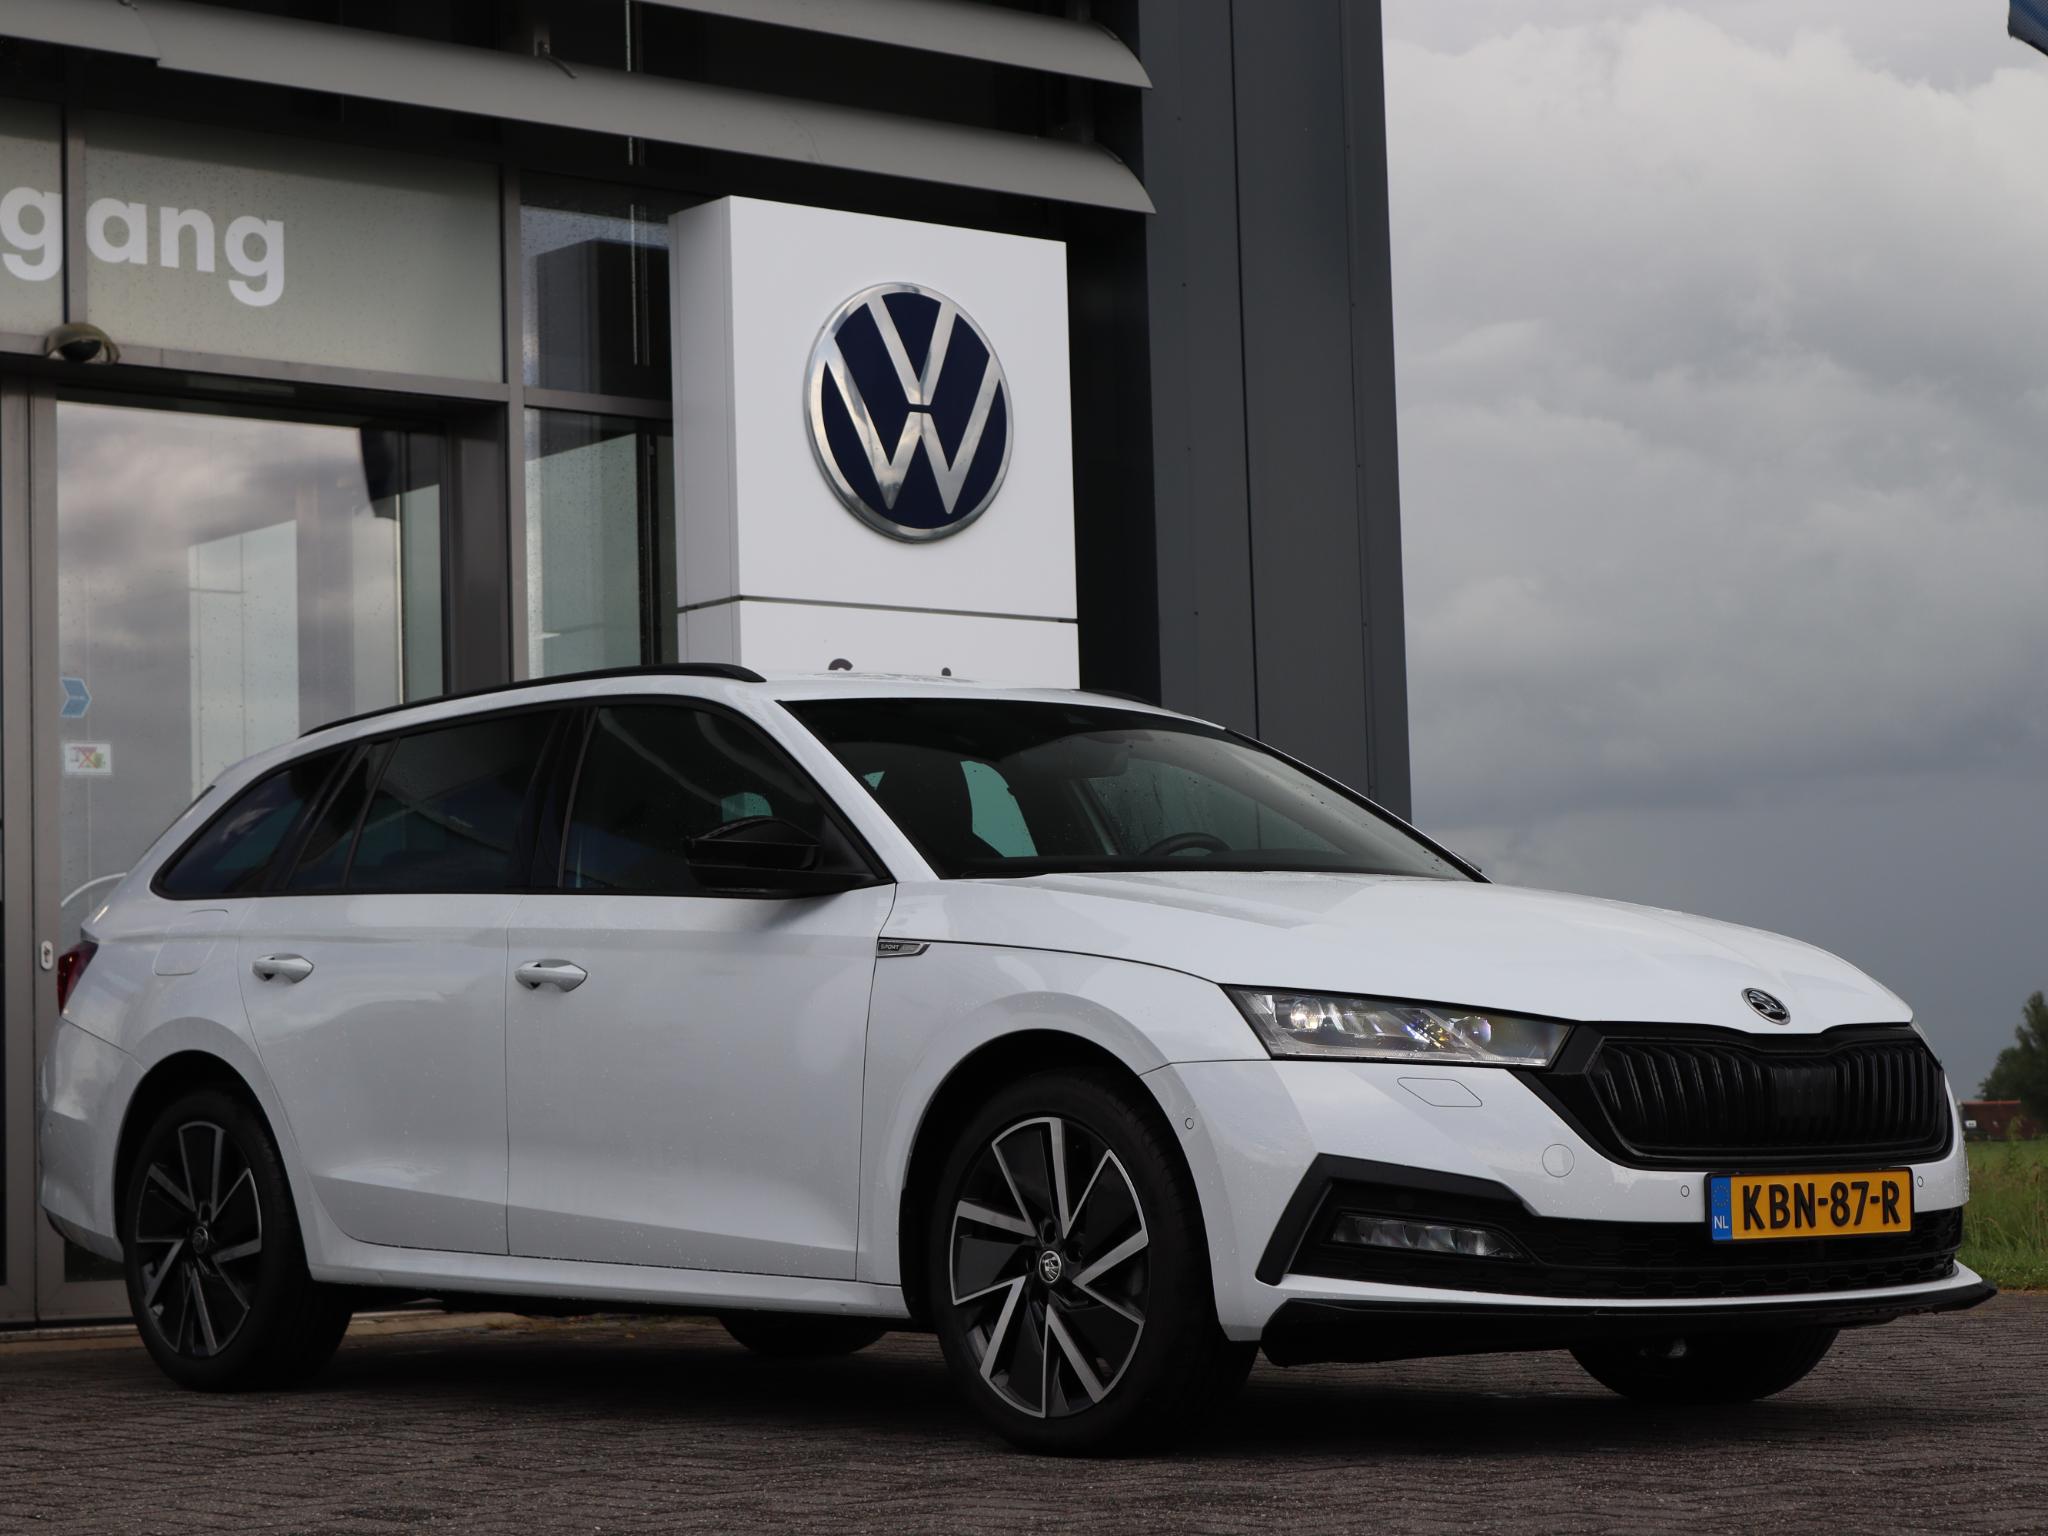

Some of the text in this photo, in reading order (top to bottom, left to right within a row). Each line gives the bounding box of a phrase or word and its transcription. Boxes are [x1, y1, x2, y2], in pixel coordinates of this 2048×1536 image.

[0, 186, 285, 307] gang
[1713, 1215, 1729, 1230] NL
[1742, 1180, 1901, 1231] KBN-87-R
